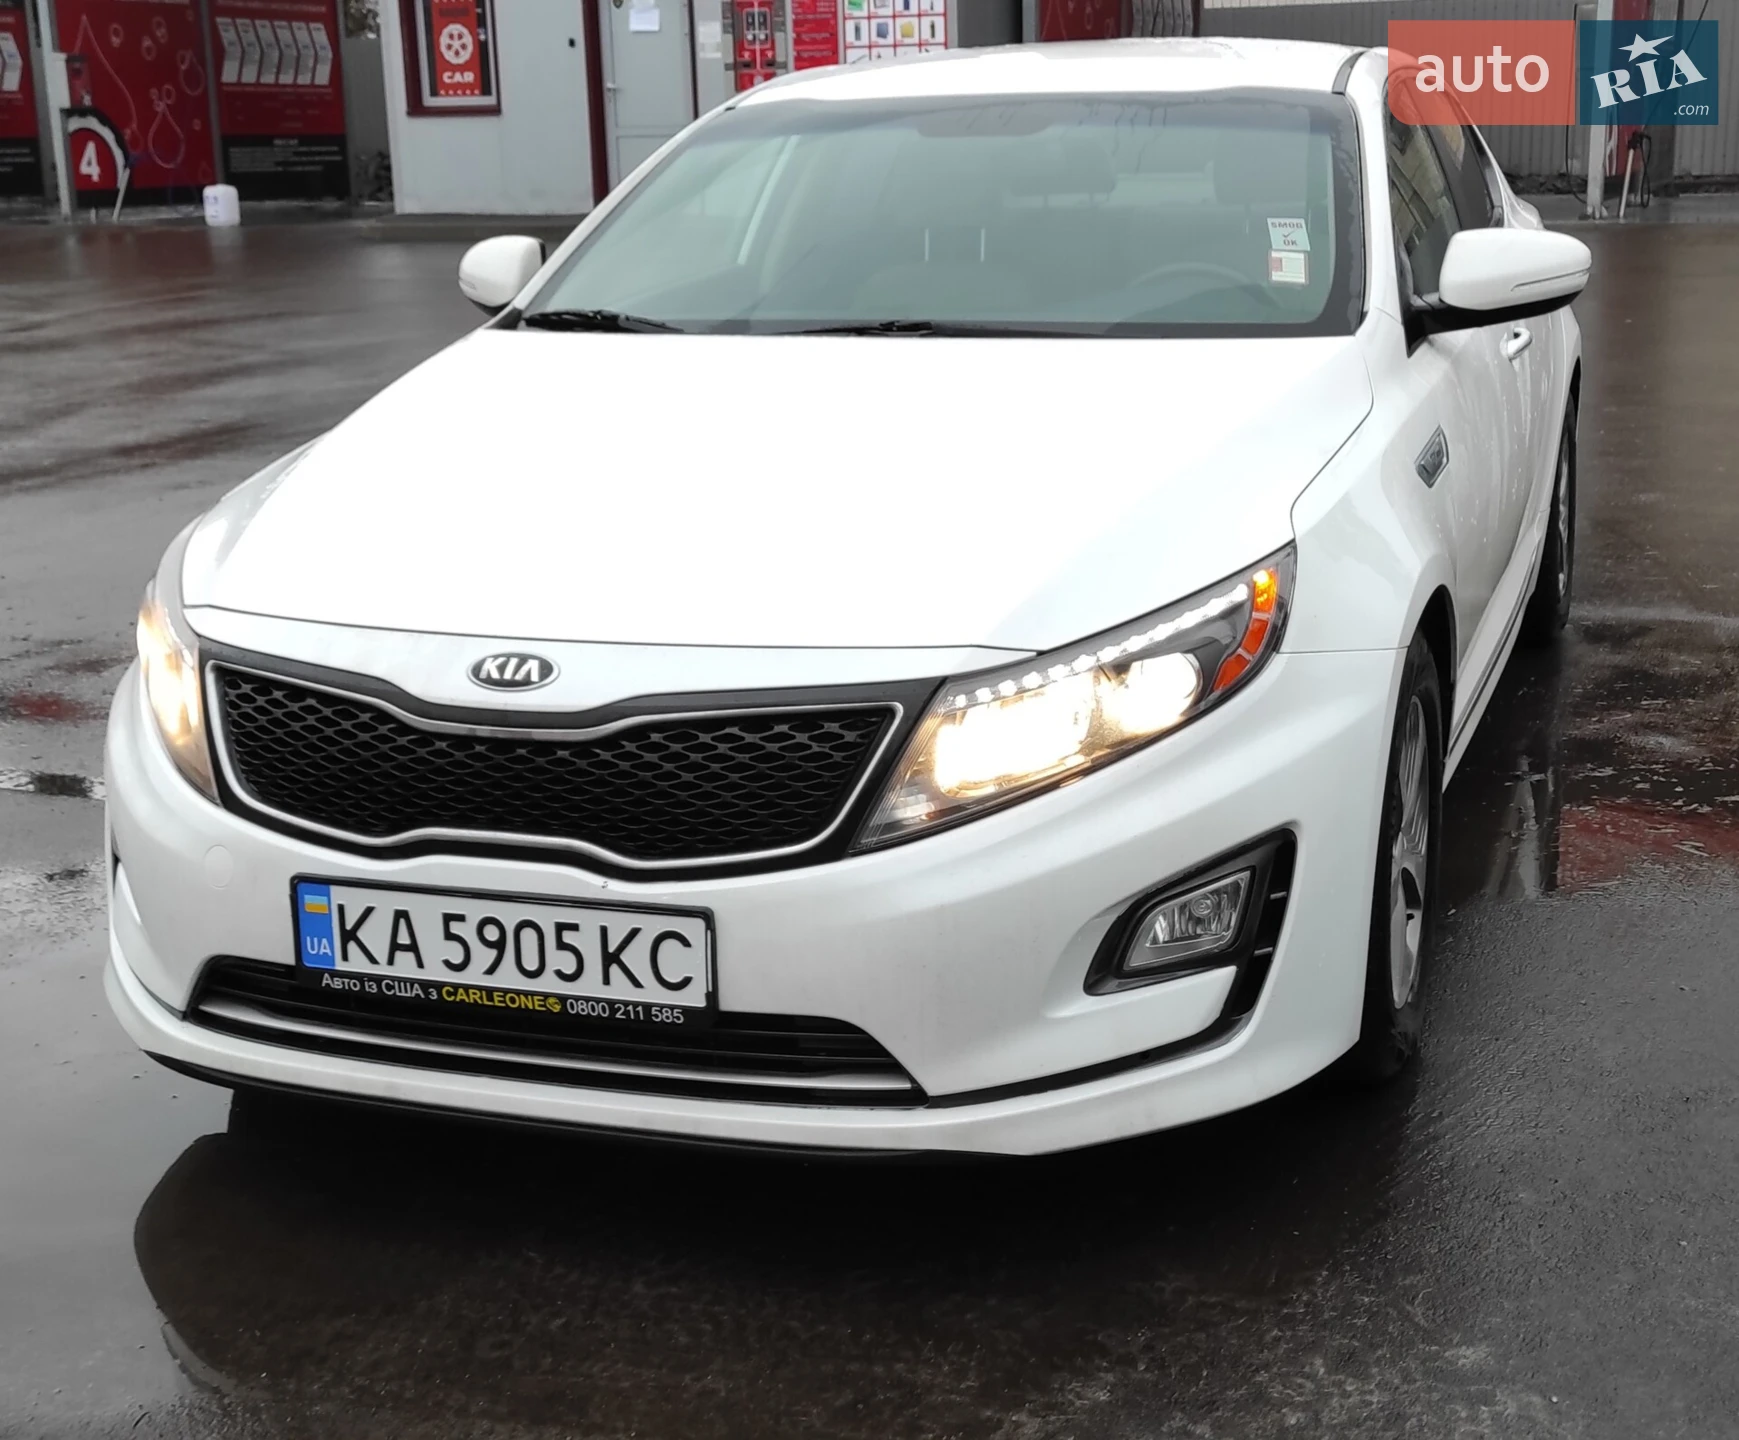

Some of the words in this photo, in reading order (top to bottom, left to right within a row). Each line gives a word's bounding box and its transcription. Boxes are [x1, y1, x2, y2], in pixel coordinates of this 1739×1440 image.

[442, 70, 475, 84] CAR
[79, 140, 101, 182] 4
[1283, 239, 1298, 247] OK
[479, 656, 540, 682] KIA
[306, 936, 332, 957] UA
[337, 902, 425, 970] KA
[441, 911, 585, 983] 5905
[599, 924, 695, 992] KC
[321, 972, 361, 992] Авто
[364, 977, 378, 993] із
[381, 979, 426, 999] США
[441, 986, 548, 1011] CARLEONE
[566, 998, 610, 1018] 0800
[614, 1003, 645, 1021] 211
[651, 1006, 685, 1024] 585
